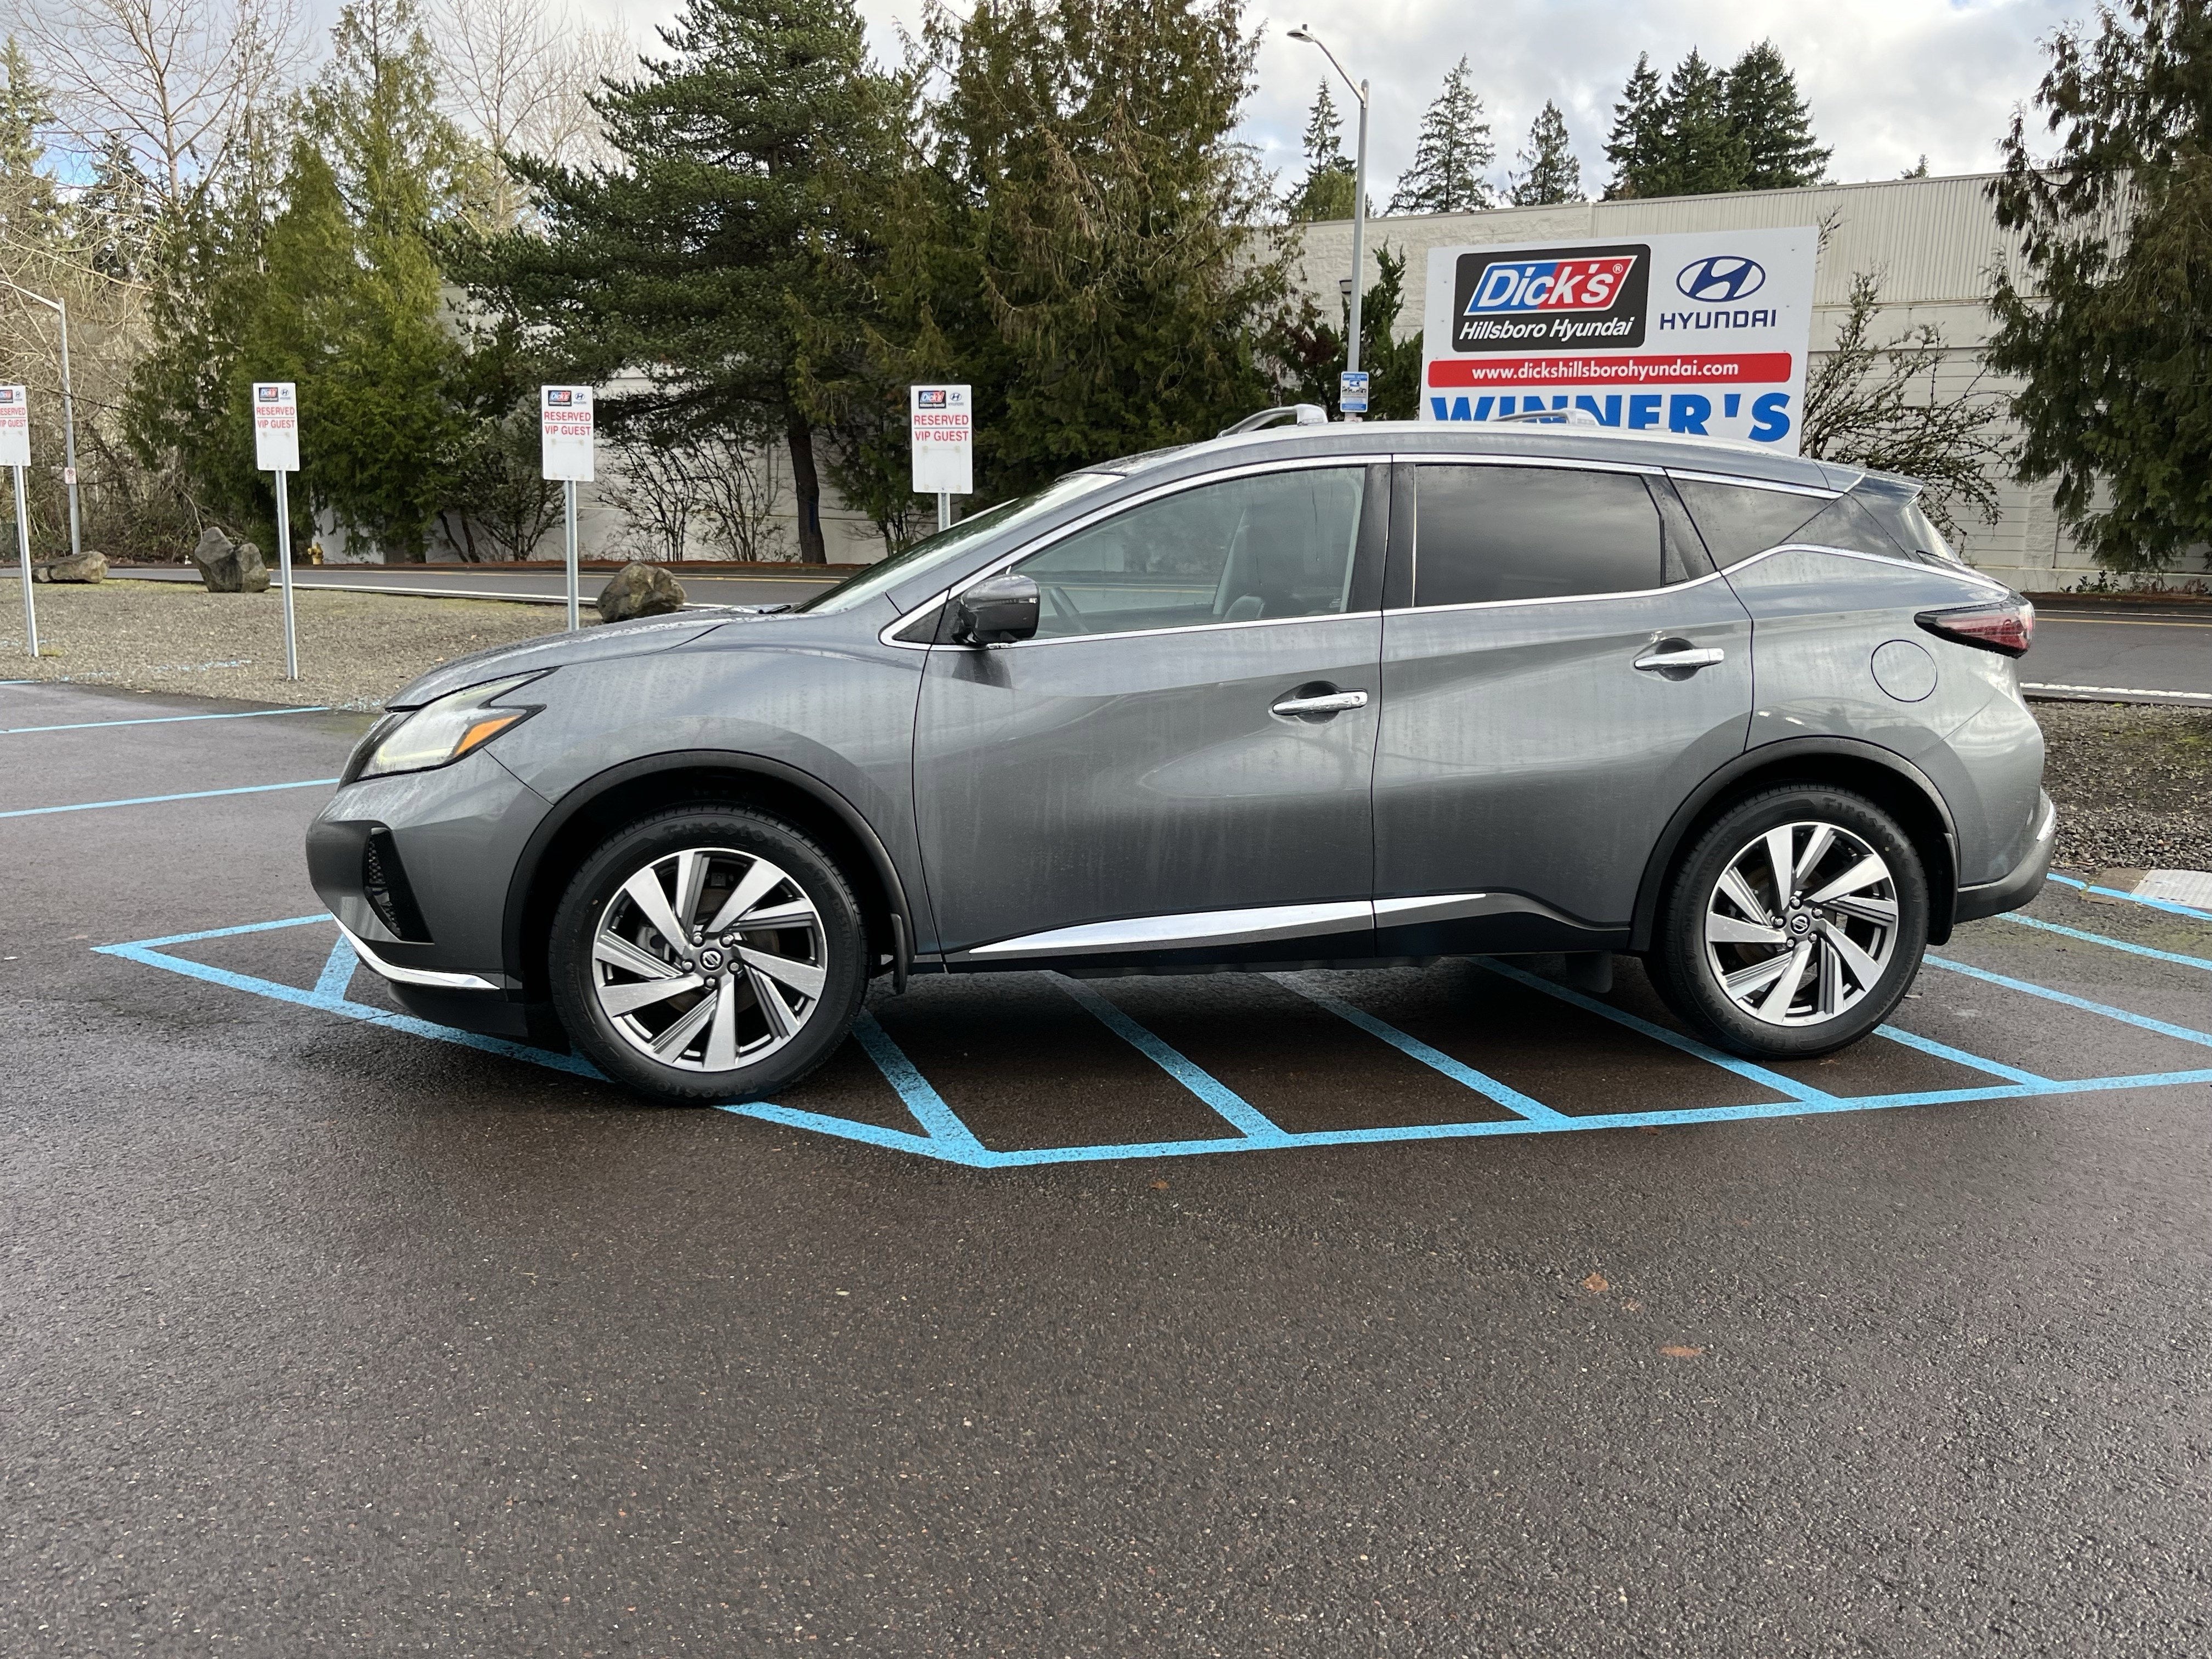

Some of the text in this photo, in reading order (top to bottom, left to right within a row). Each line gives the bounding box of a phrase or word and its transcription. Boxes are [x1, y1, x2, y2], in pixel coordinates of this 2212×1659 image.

[1477, 263, 1614, 307] Dick's
[1660, 309, 1776, 330] HYUNDAI
[1459, 317, 1635, 342] Hillsboro Hyundai
[1471, 359, 1739, 382] www.dickshillsborohyundai.com
[0, 408, 26, 416] ESERVED
[256, 407, 295, 416] RESERVED
[544, 411, 591, 421] RESERVED
[257, 420, 295, 428] VIP GUEST
[914, 415, 969, 426] RESERVED
[544, 425, 591, 436] VIP GUEST
[915, 431, 969, 442] VIP GUEST
